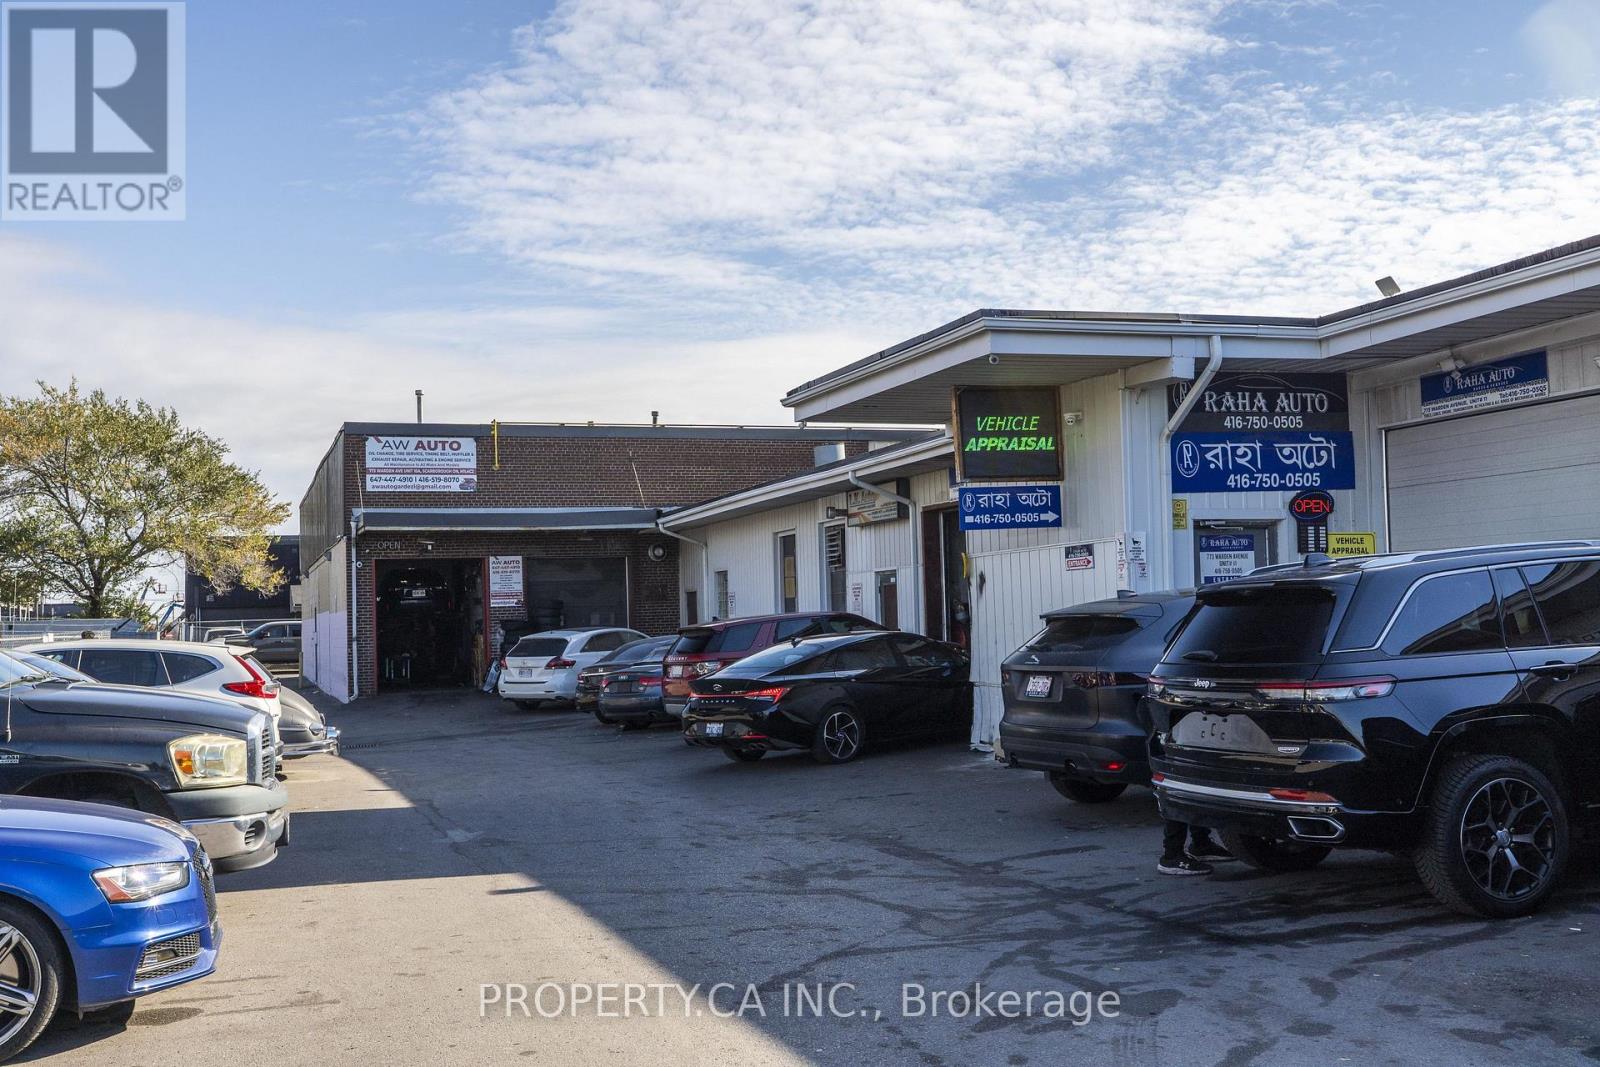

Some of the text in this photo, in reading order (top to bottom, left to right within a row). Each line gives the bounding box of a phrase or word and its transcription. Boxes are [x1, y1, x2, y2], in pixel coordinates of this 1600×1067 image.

[1457, 373, 1485, 390] RAHA
[1489, 367, 1515, 383] AUTO
[1204, 391, 1329, 413] RAHA AUTO
[976, 416, 1040, 431] VEHICLE
[1224, 416, 1304, 429] 416-750-0505
[381, 440, 462, 452] AW AUTO
[964, 437, 1056, 452] APPRAISAL
[1200, 432, 1337, 472] রাহা অটো
[1227, 473, 1320, 488] 416-750-0505
[976, 488, 1052, 509] রাহা অটো
[1294, 500, 1330, 512] OPEN
[974, 512, 1040, 524] 416-750-0505
[378, 541, 400, 549] OPEN
[1194, 678, 1210, 688] Jeep
